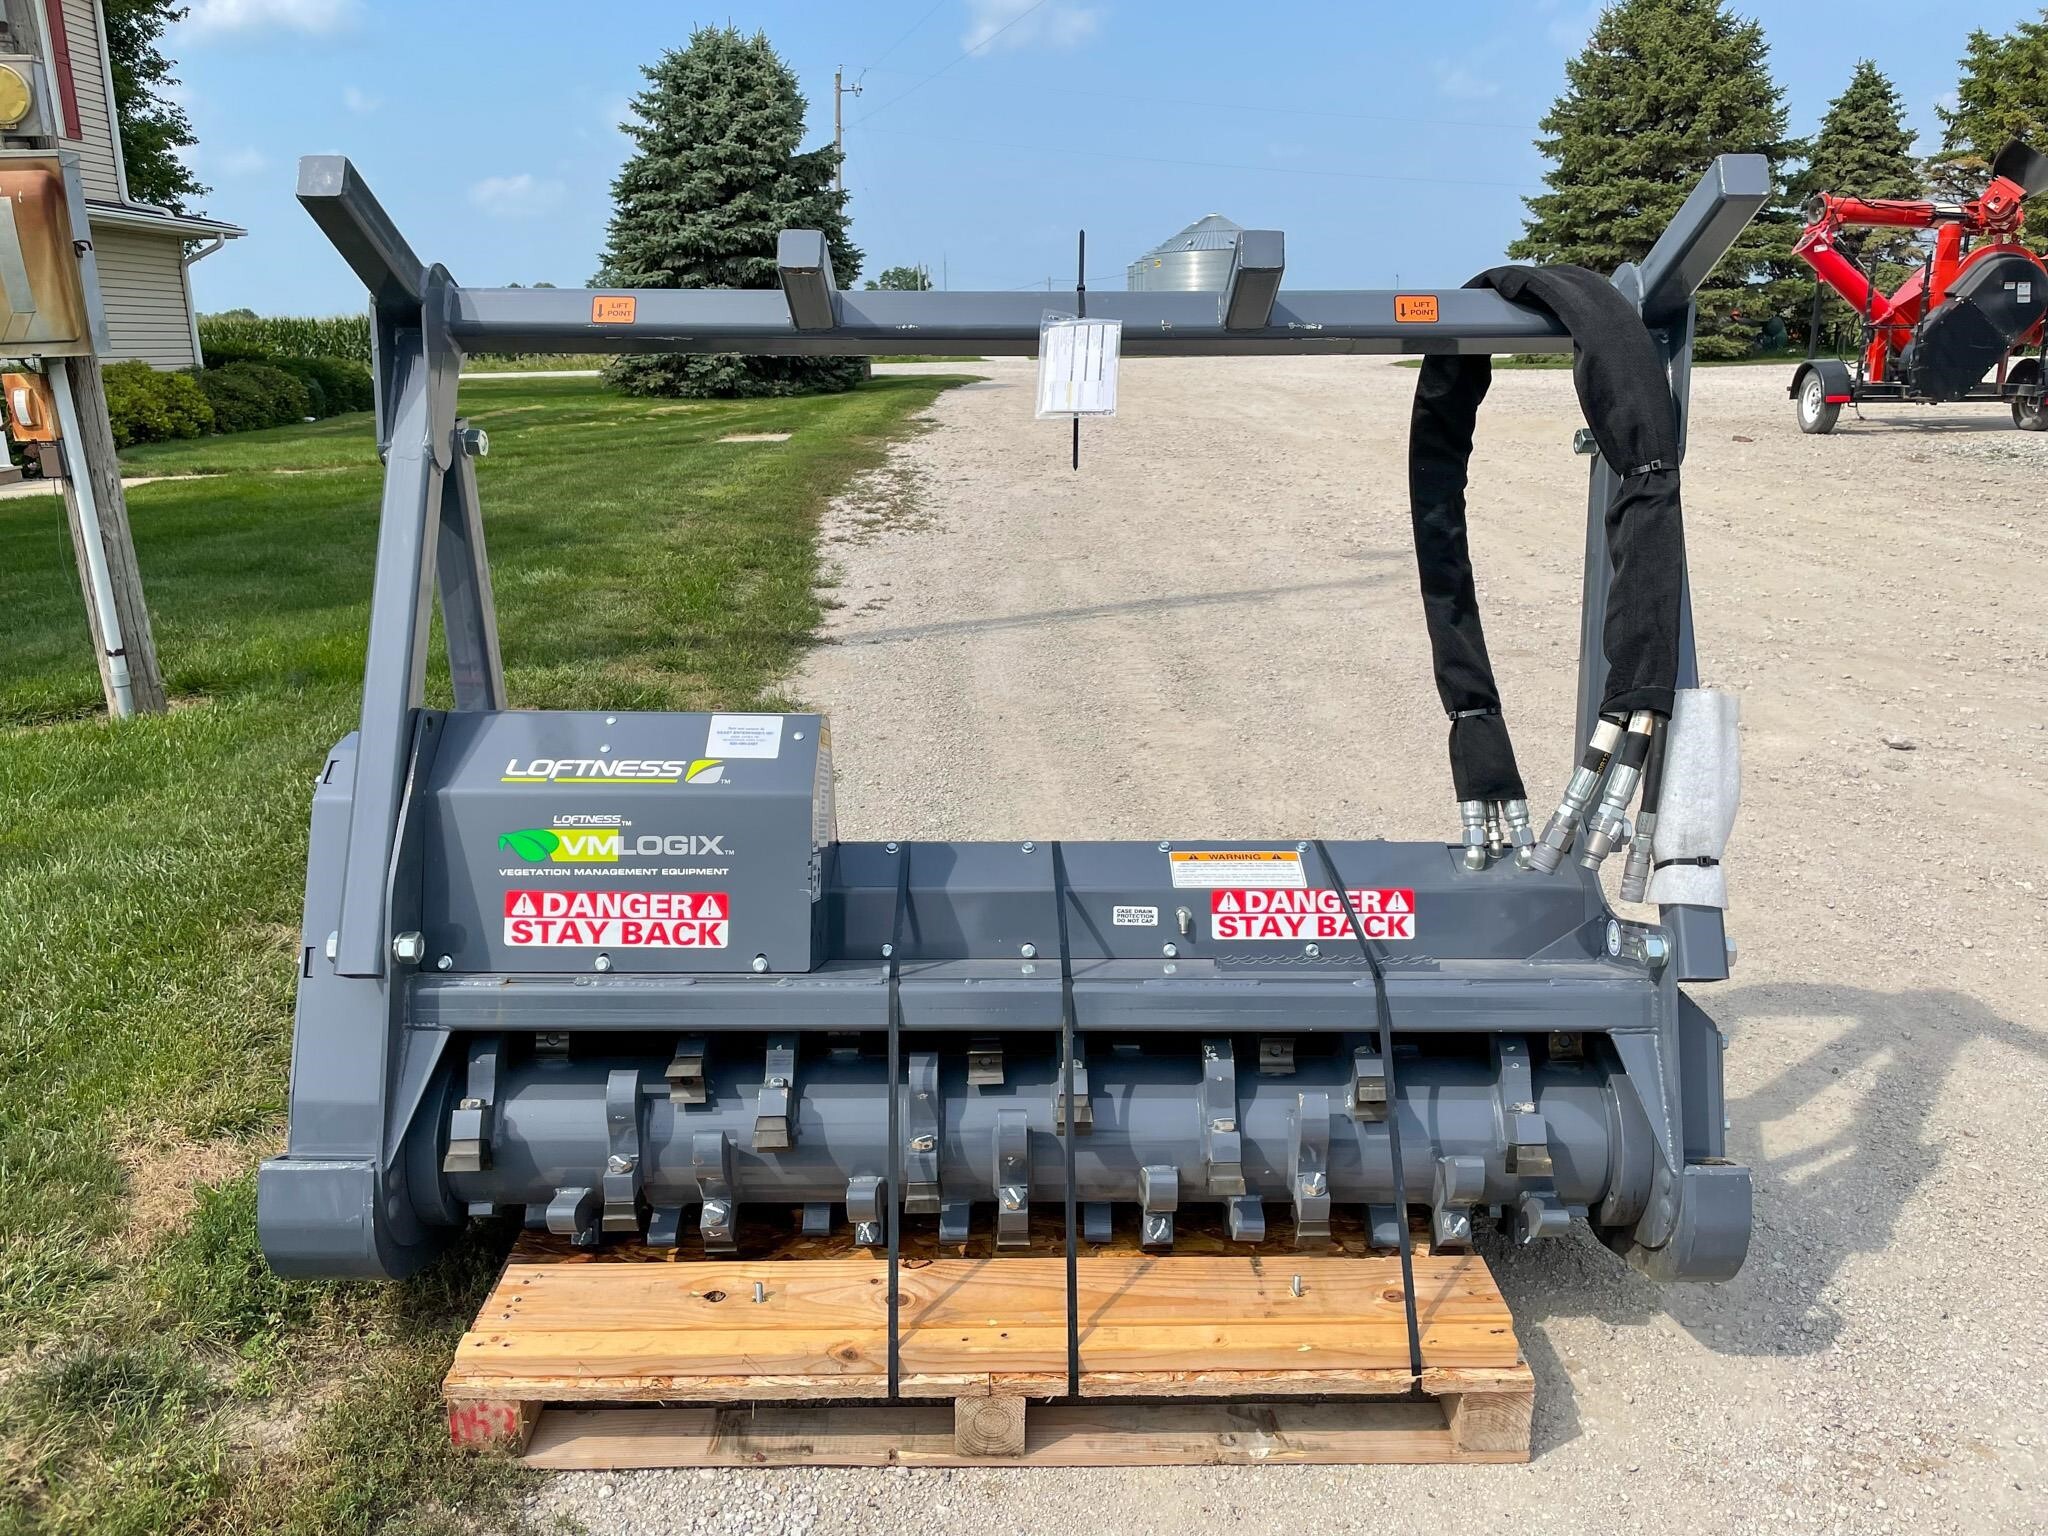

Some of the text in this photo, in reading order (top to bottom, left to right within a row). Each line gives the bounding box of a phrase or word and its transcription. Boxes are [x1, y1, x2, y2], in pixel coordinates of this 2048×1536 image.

[505, 759, 686, 778] LOFTNESS
[553, 814, 622, 825] LOFTNESS
[561, 835, 725, 856] VMLOGIX
[498, 867, 730, 877] VEGETATION MANAGEMENT EQUIPMENT
[543, 893, 692, 918] DANGER
[1245, 890, 1382, 913] DANGER
[511, 920, 722, 946] STAY BACK
[1218, 915, 1409, 938] STAY BACK
